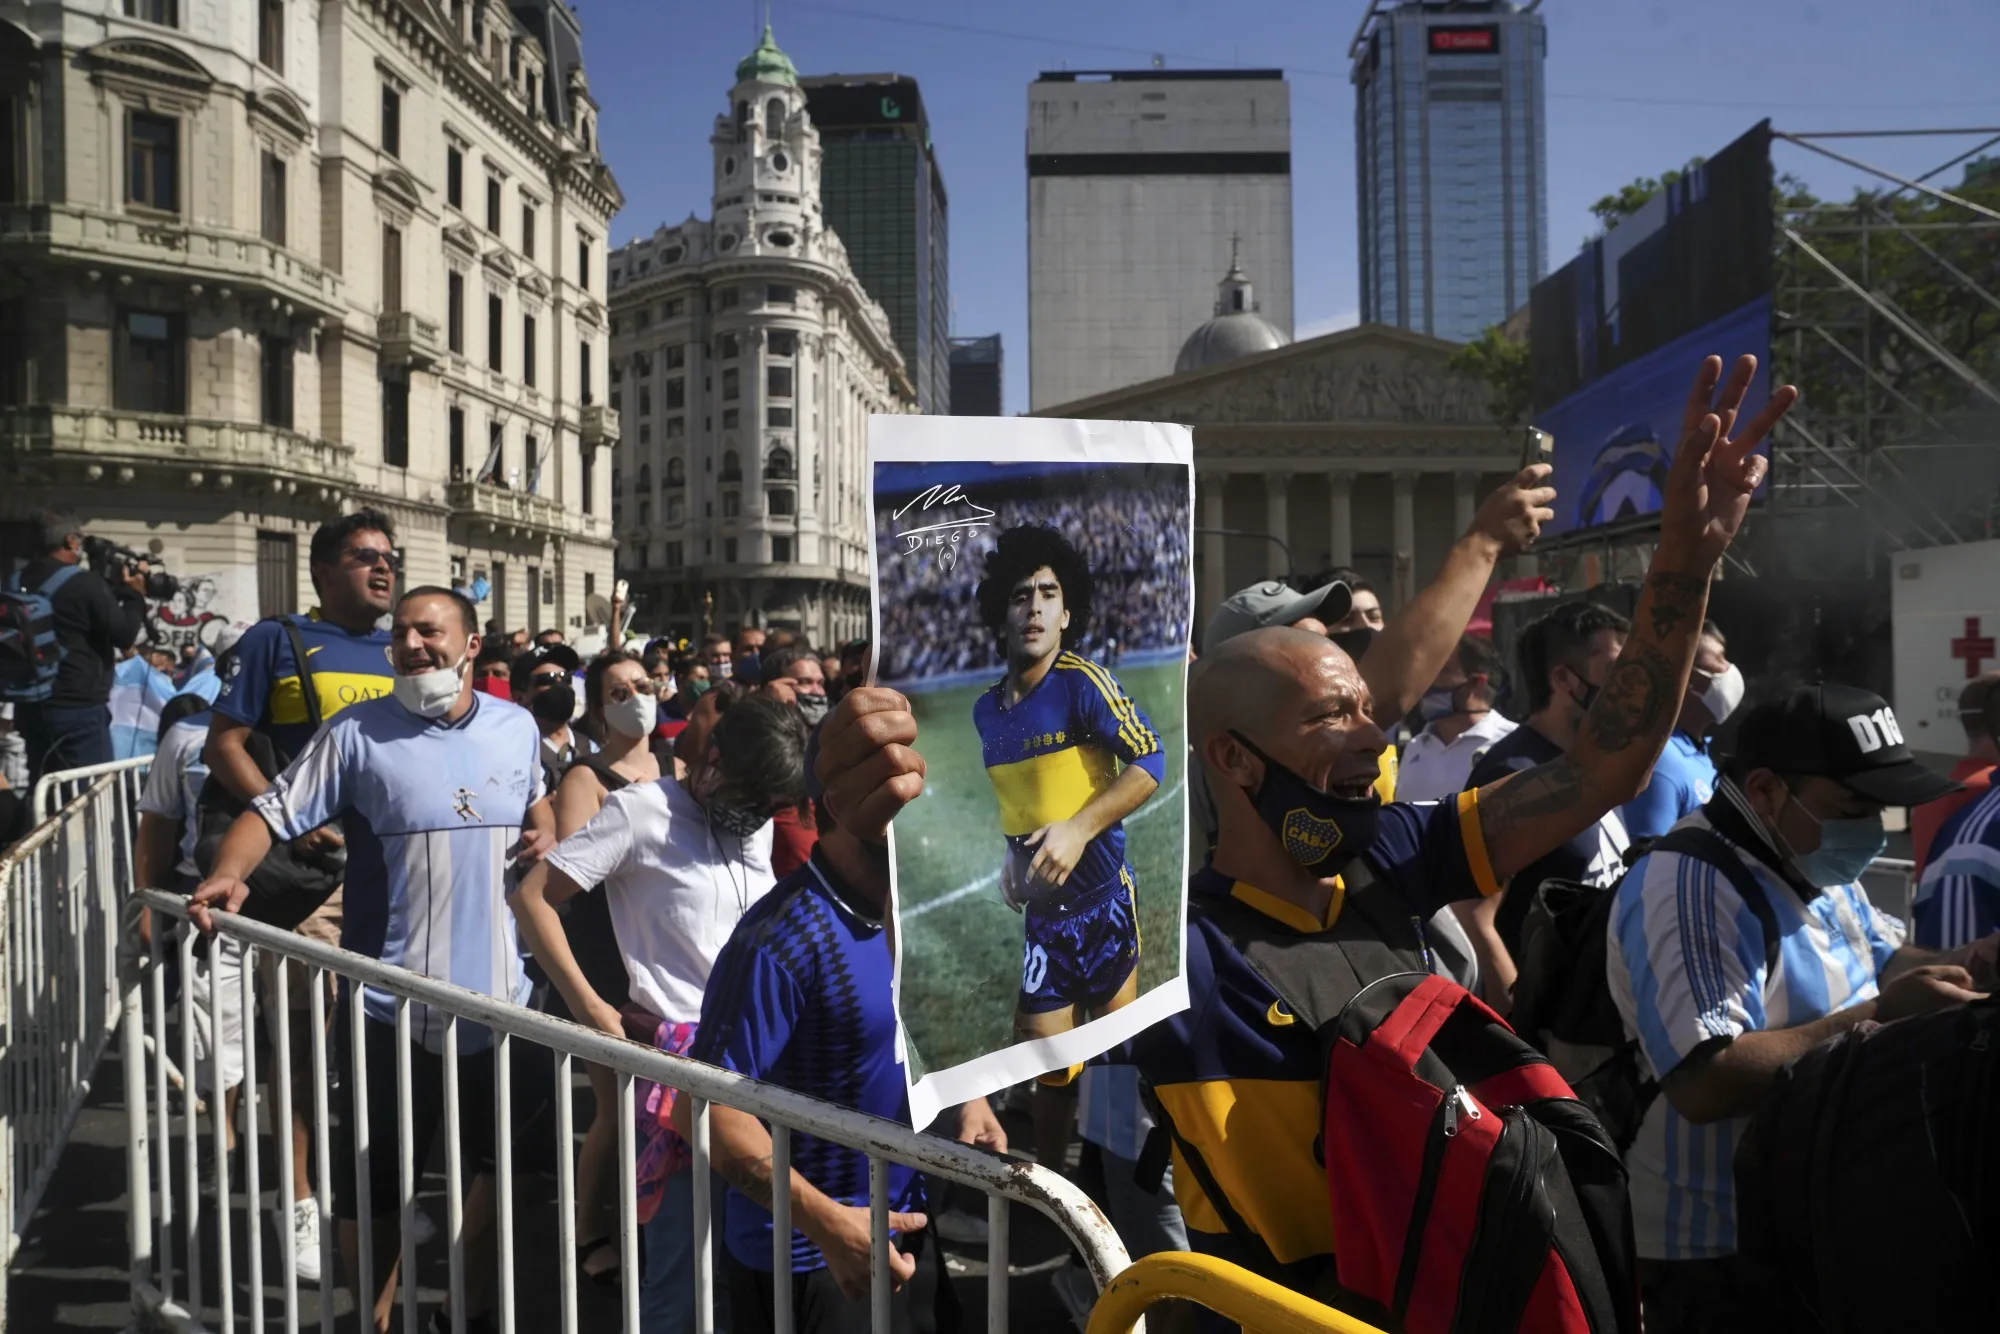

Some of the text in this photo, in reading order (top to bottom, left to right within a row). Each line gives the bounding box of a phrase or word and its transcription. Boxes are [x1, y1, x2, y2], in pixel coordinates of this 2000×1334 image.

[903, 530, 978, 556] DIEGO
[338, 685, 393, 704] QAT
[1288, 826, 1330, 848] CABJ
